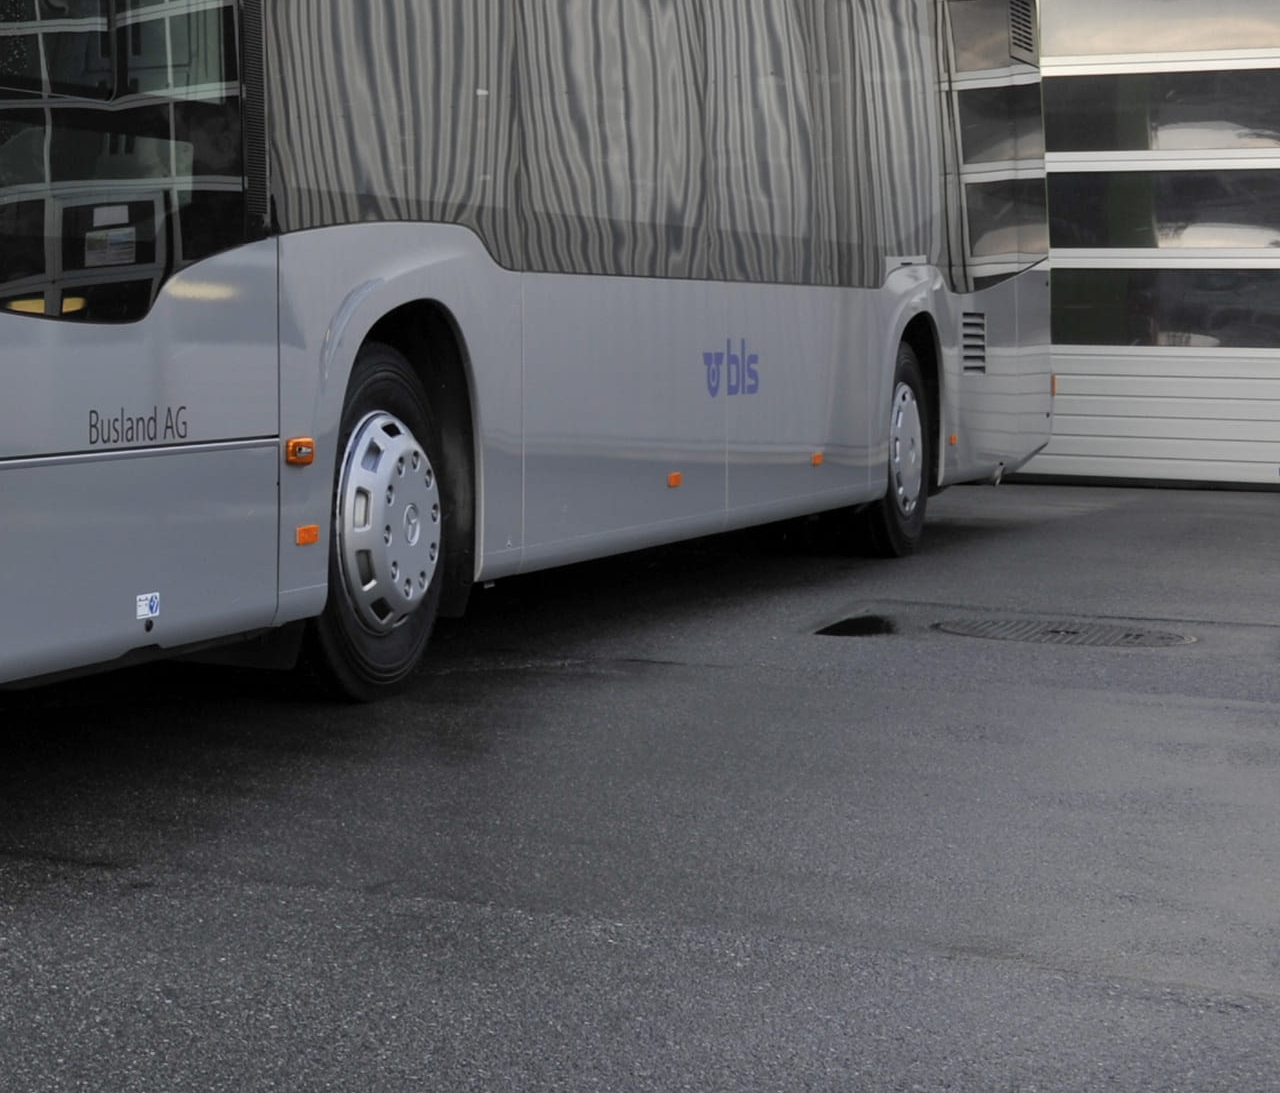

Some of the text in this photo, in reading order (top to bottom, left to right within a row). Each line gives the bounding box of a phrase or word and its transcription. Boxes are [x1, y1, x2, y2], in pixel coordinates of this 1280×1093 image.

[727, 338, 759, 396] bls
[89, 405, 187, 445] Busland AG
